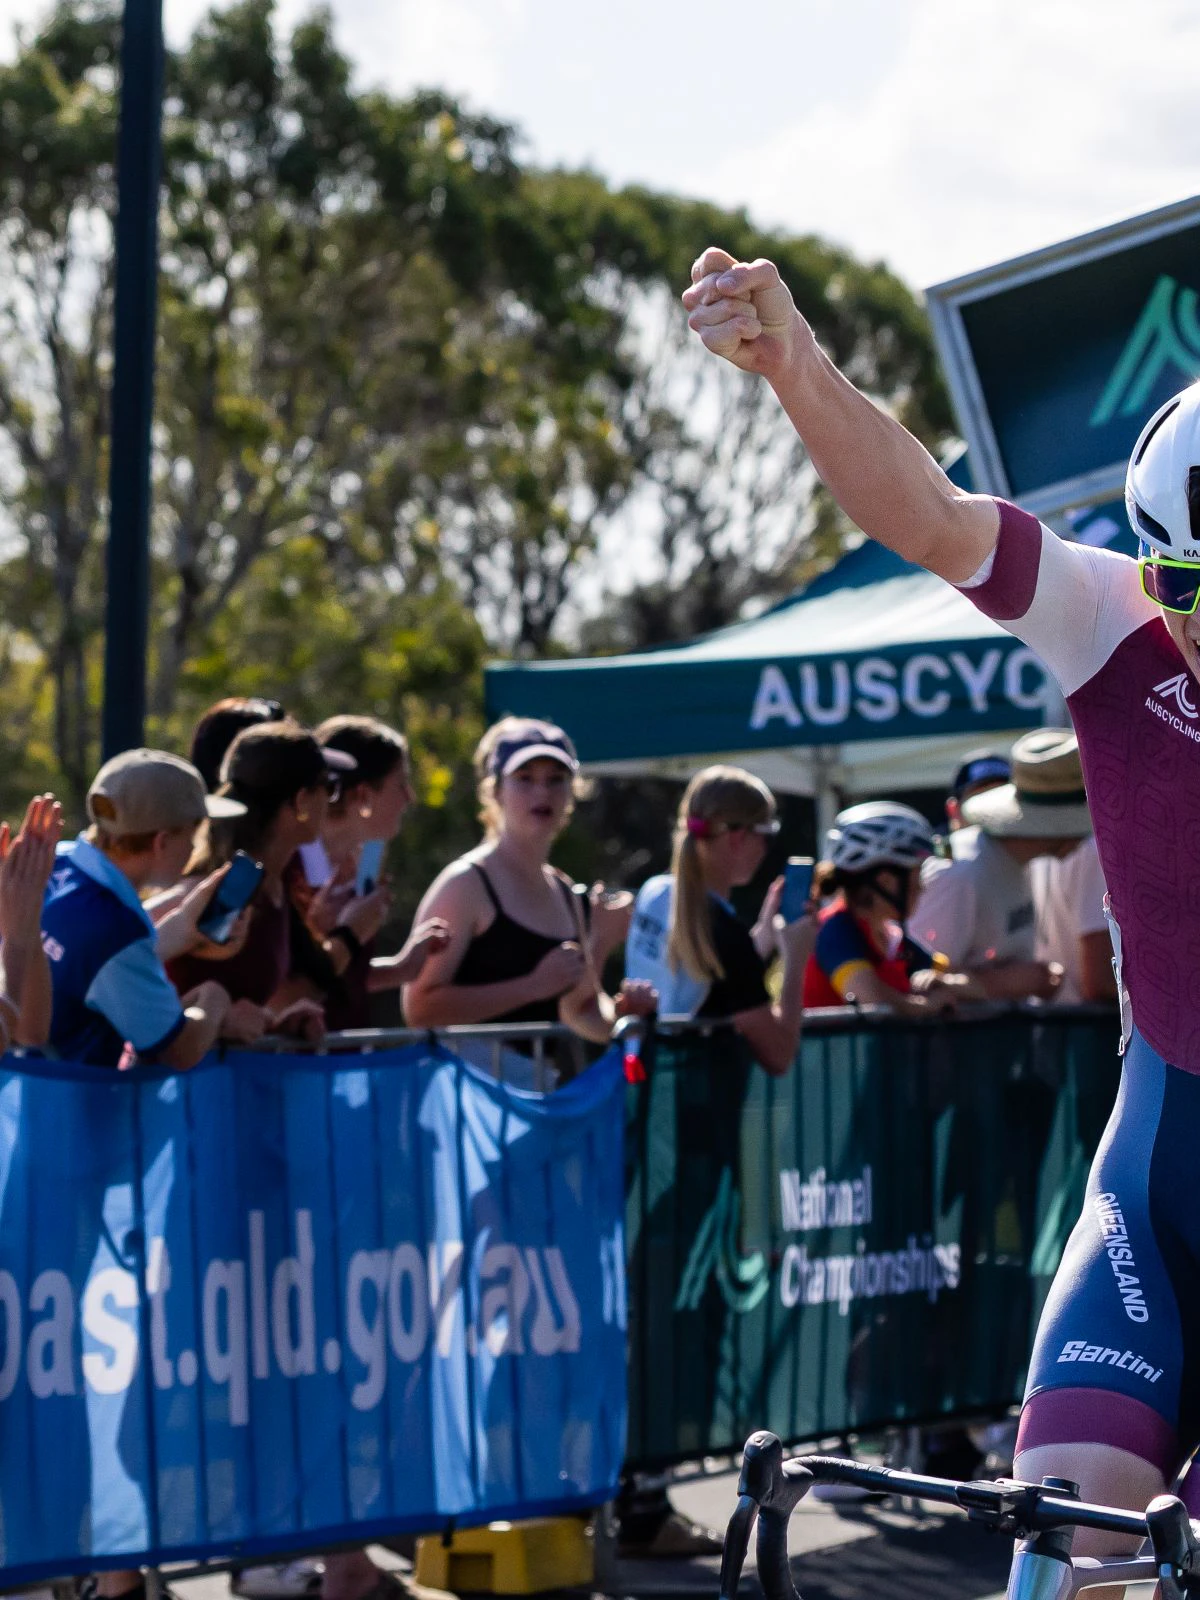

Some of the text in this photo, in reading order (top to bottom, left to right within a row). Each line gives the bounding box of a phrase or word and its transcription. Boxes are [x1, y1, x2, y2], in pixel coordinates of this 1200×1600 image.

[1145, 697, 1200, 743] AUSCYCLING
[1096, 1192, 1149, 1324] QUEENSLAND
[1057, 1340, 1164, 1383] Santini
